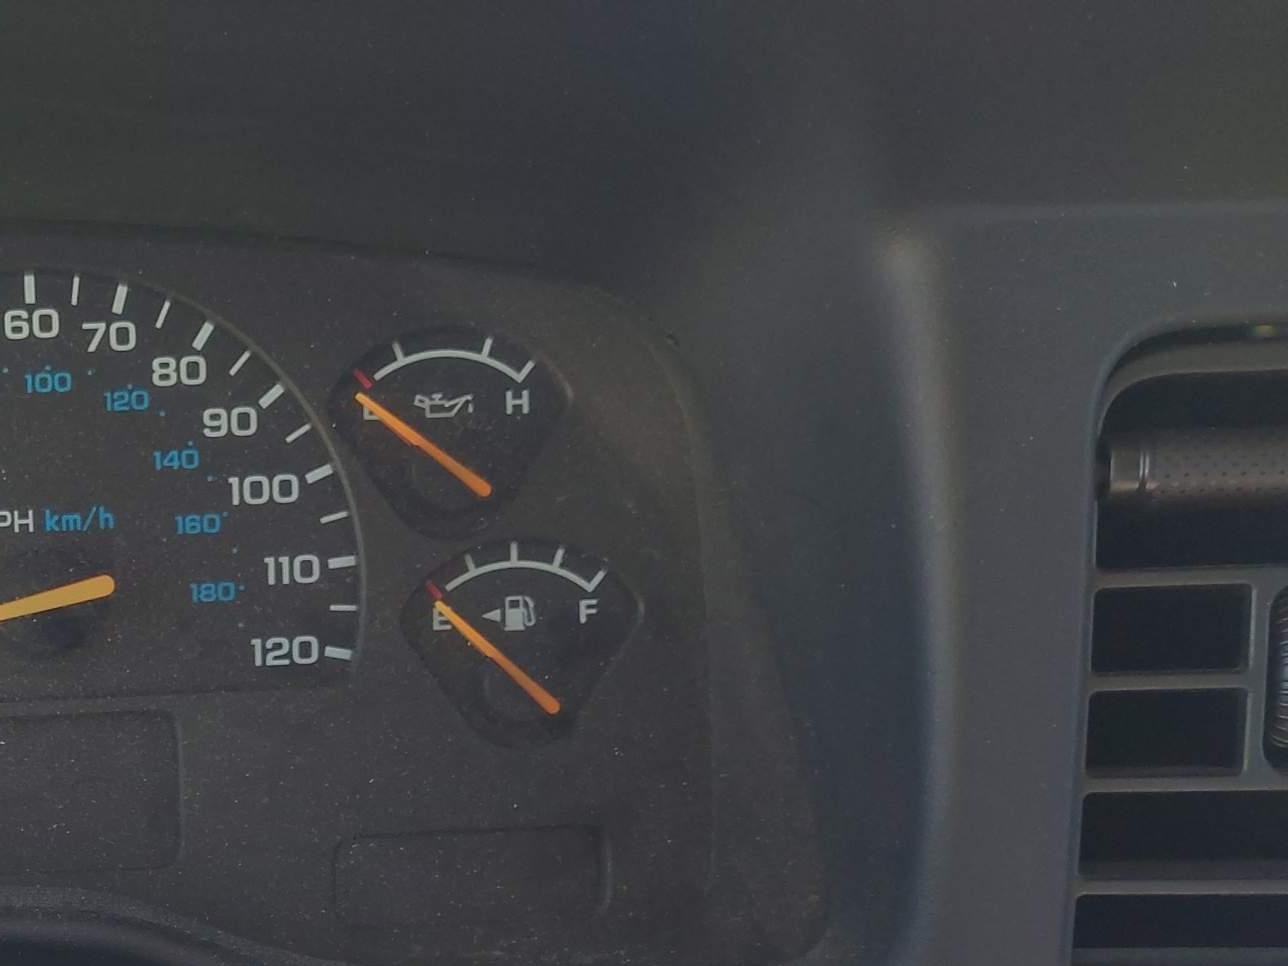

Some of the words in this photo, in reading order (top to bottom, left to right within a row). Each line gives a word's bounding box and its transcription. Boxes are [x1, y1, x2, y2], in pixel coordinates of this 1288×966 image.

[5, 309, 59, 339] 60
[82, 322, 136, 352] 70
[25, 372, 71, 393] 100
[152, 356, 206, 386] 80
[105, 390, 150, 411] 120
[506, 390, 530, 414] H
[203, 407, 257, 437] 90
[153, 448, 199, 469] 140
[228, 474, 298, 505] 100
[44, 506, 115, 532] km/h
[175, 514, 220, 534] 160
[264, 555, 319, 585] 110
[191, 581, 235, 602] 180
[580, 599, 598, 623] F
[251, 636, 318, 666] 120
